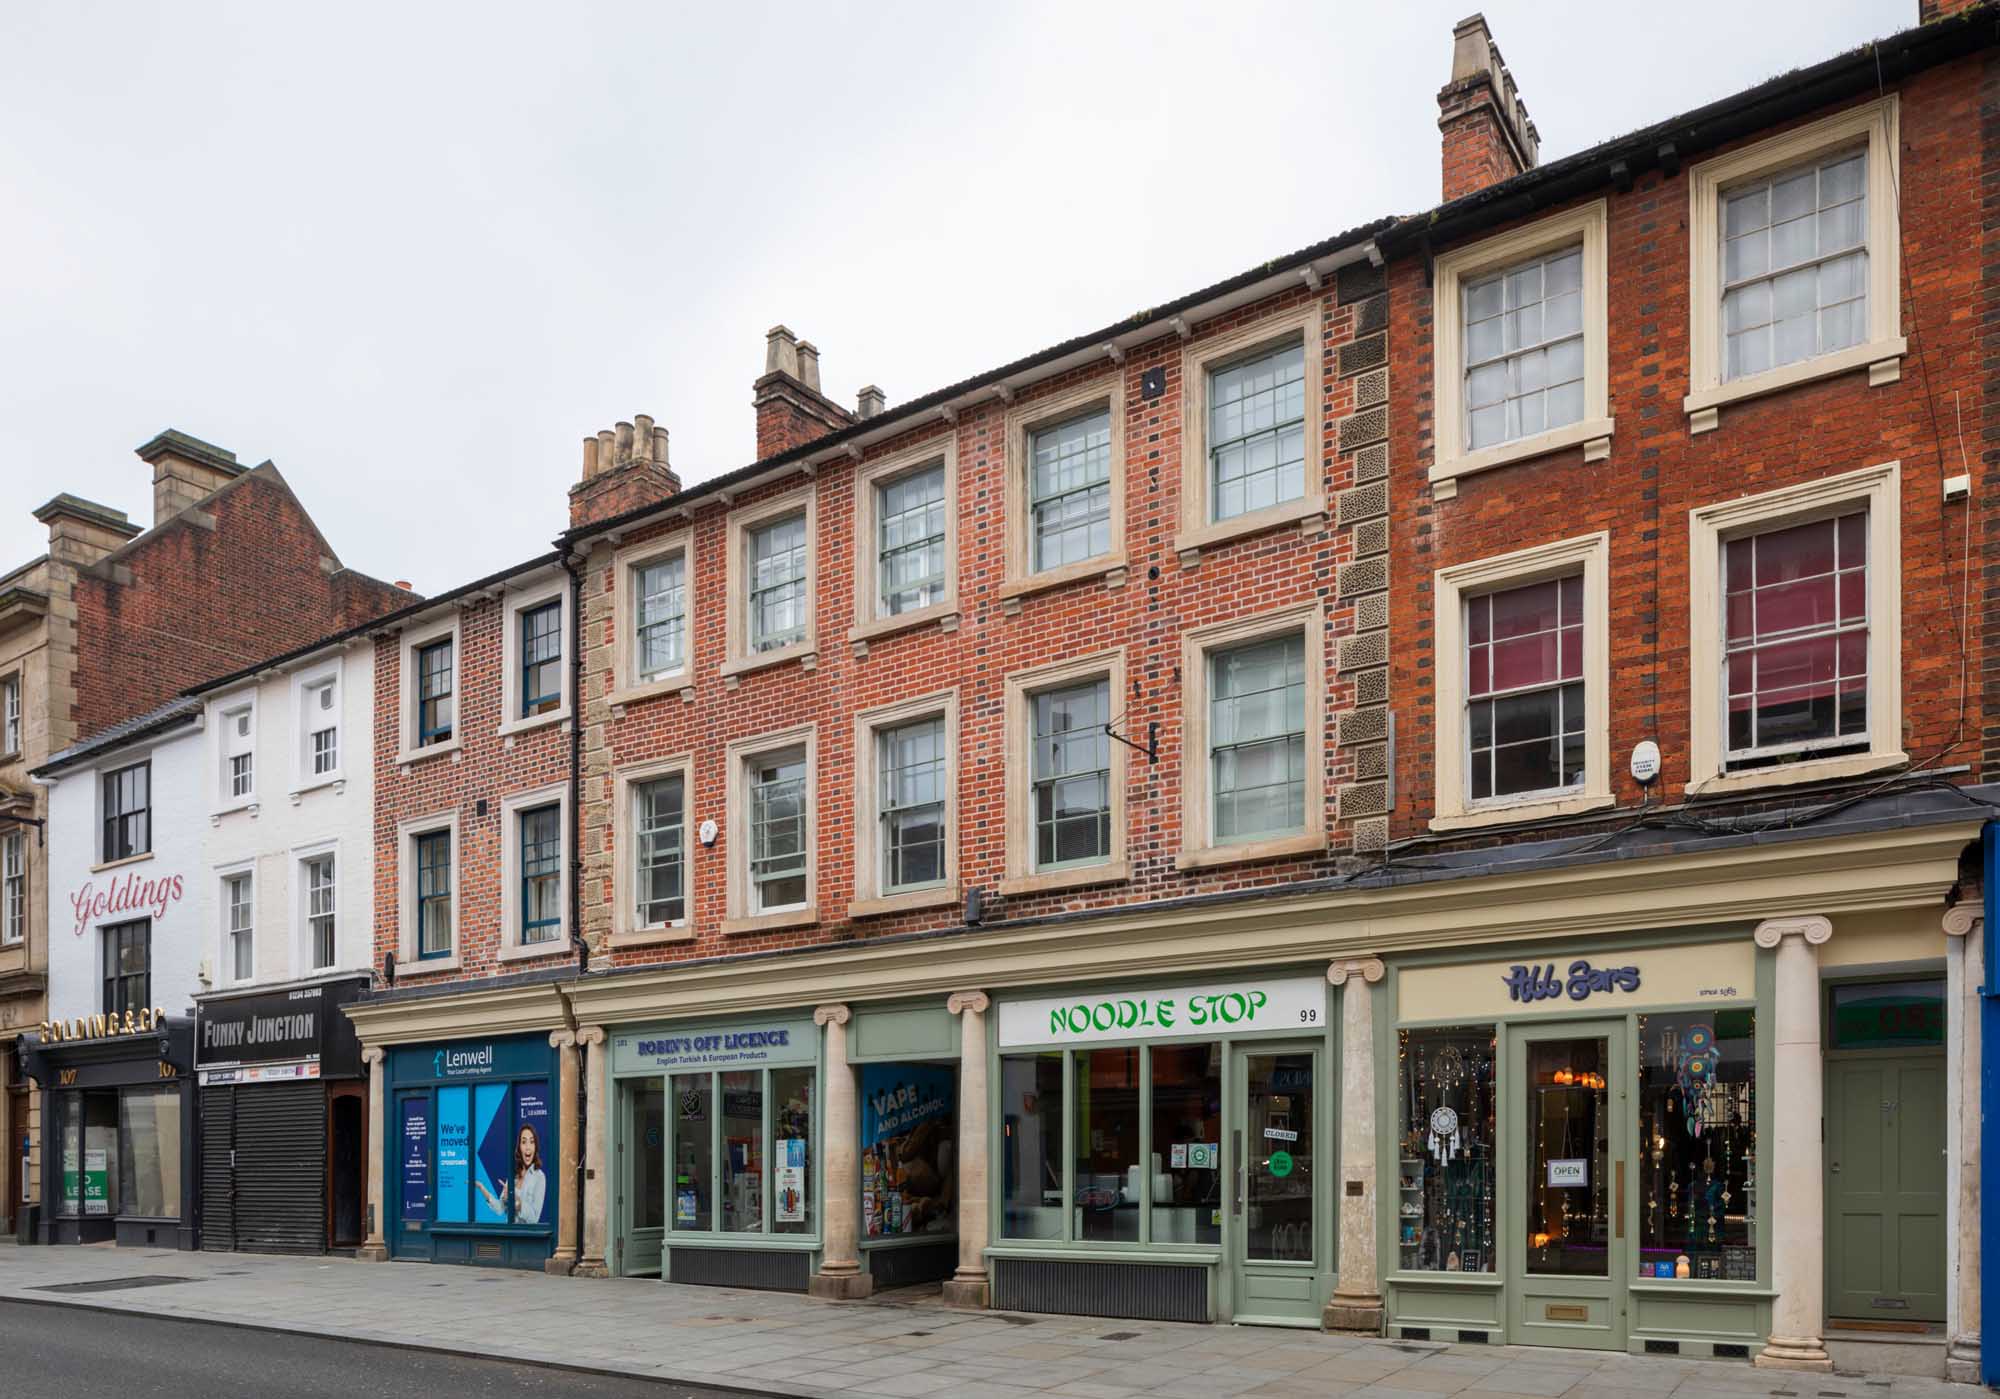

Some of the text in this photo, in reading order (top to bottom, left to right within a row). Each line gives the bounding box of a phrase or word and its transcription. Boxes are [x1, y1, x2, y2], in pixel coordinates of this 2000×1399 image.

[71, 872, 184, 936] Goldings
[1501, 960, 1641, 1003] All Ears
[1050, 990, 1267, 1035] NOODLE STOP
[1300, 1009, 1317, 1023] 99
[41, 1012, 119, 1044] GOLDING
[204, 1013, 314, 1048] FUNKY JUNCTION
[446, 1045, 492, 1067] Lenwell
[638, 1030, 788, 1056] ROBIN'S OFF LICENCE
[657, 1057, 677, 1066] English
[679, 1056, 701, 1064] Turkish
[709, 1053, 738, 1063] European
[739, 1051, 767, 1060] Products
[60, 1069, 78, 1086] 107
[873, 1084, 918, 1116] VAPE
[878, 1097, 944, 1134] AND ALCOHOL
[441, 1124, 465, 1134] We've
[441, 1136, 470, 1147] moved
[1554, 1166, 1580, 1176] OPEN
